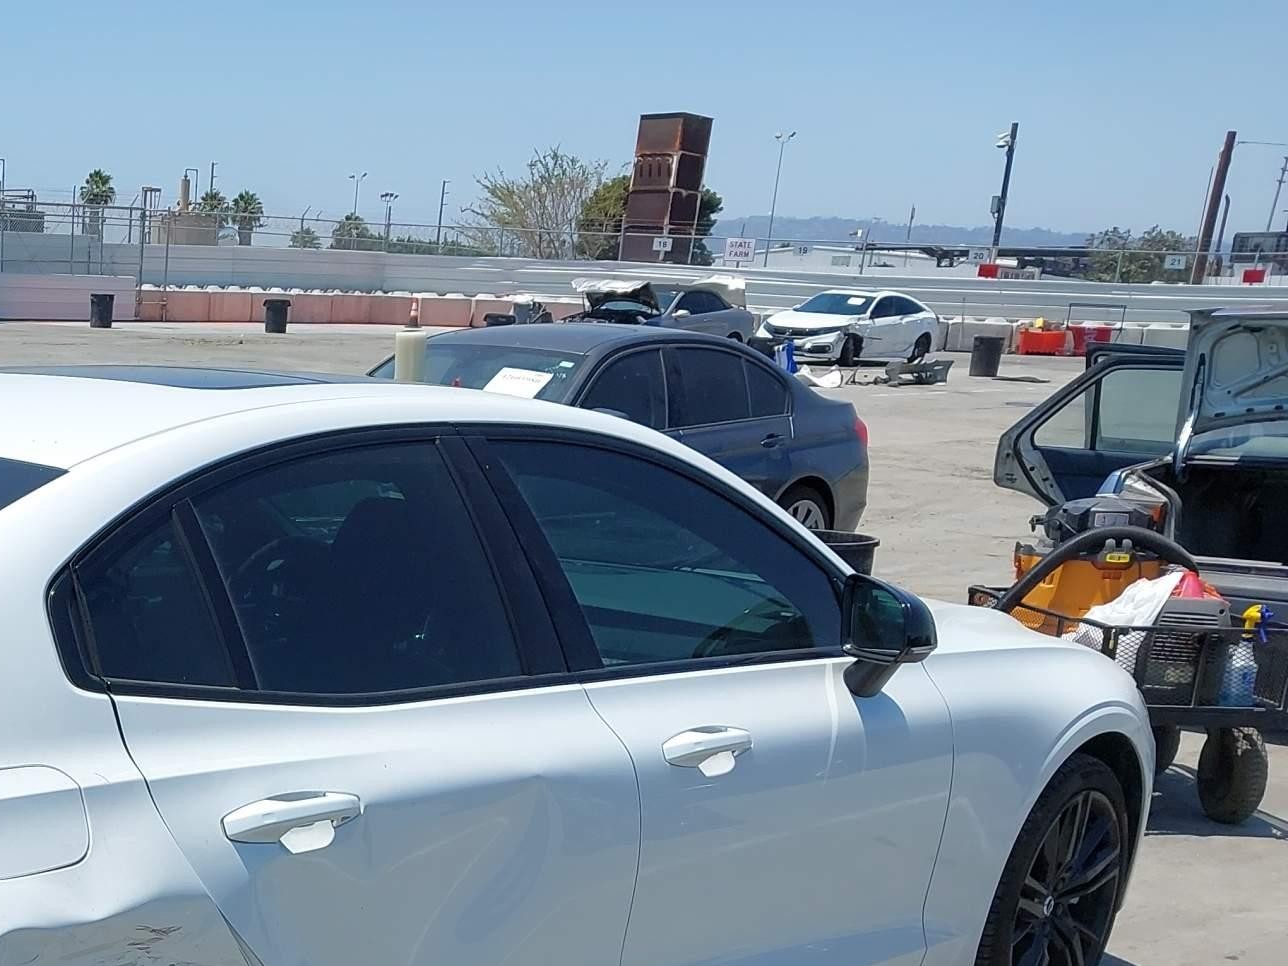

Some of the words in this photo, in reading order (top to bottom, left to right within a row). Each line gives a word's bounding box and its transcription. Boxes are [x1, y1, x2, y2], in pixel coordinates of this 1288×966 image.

[729, 241, 753, 249] STATE
[728, 250, 750, 258] FARM
[798, 246, 808, 255] 19
[973, 252, 984, 260] 20
[1170, 258, 1182, 266] 21
